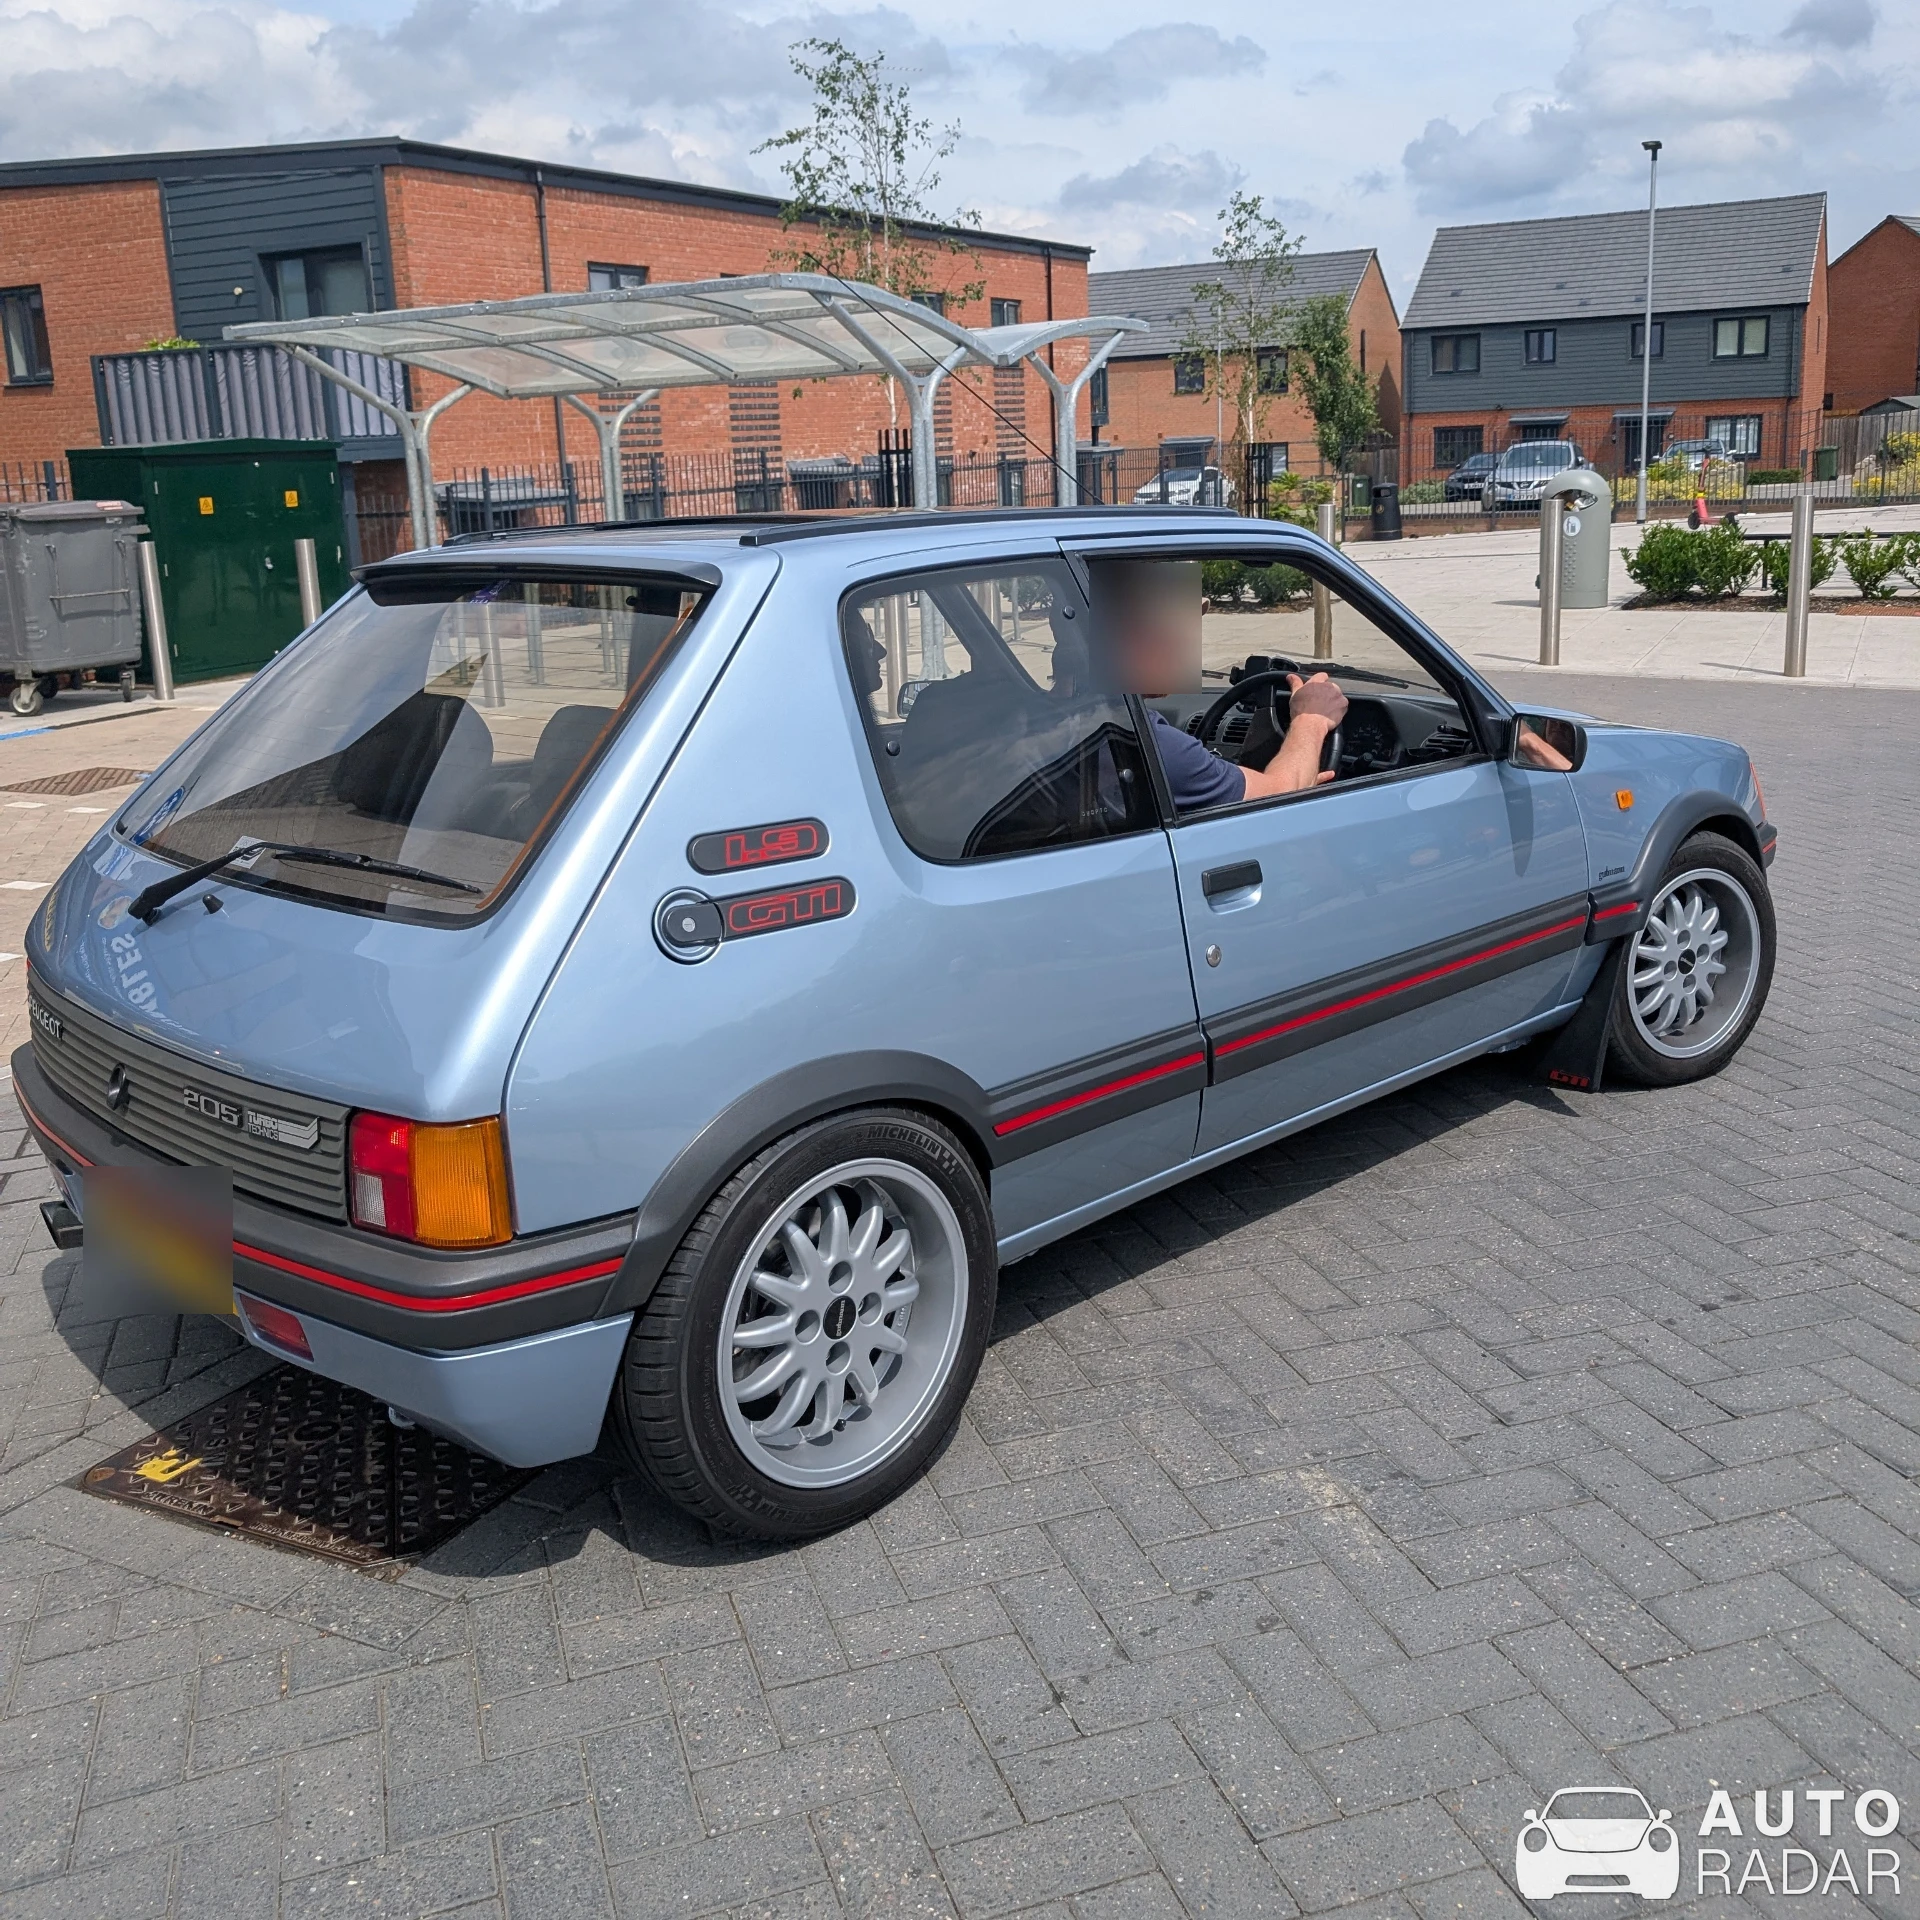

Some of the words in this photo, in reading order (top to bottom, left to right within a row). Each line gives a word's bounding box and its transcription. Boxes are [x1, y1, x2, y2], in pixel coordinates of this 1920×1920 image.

[728, 884, 841, 933] GTI
[183, 1088, 240, 1126] 205
[247, 1110, 279, 1130] TURBO
[247, 1122, 280, 1141] TECHNICS
[867, 1125, 941, 1156] MICHELIN
